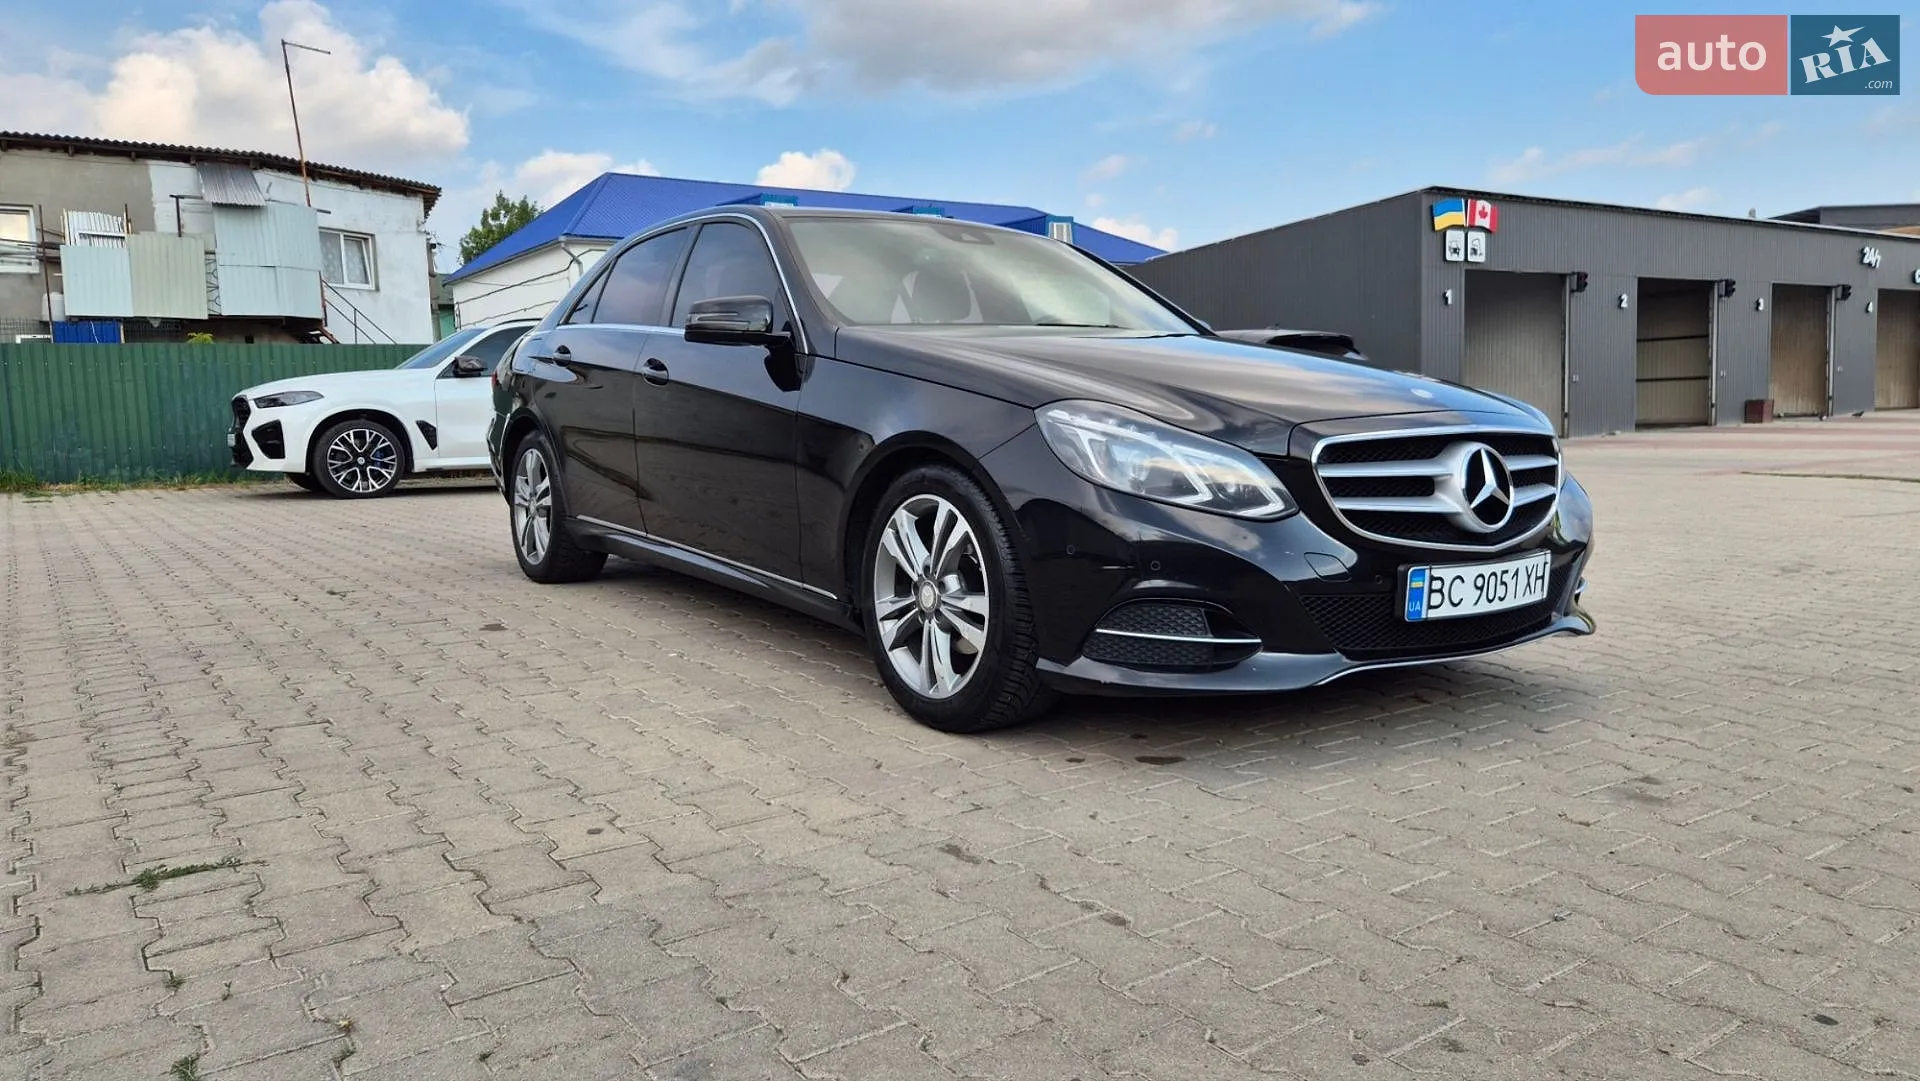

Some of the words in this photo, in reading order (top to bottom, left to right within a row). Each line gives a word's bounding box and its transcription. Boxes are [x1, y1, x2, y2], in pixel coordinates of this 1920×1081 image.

[1446, 289, 1453, 304] 1
[1620, 293, 1628, 308] 2
[1429, 574, 1465, 609] BC
[1473, 567, 1520, 606] 9051
[1522, 562, 1546, 598] XH
[1408, 603, 1421, 612] UA
